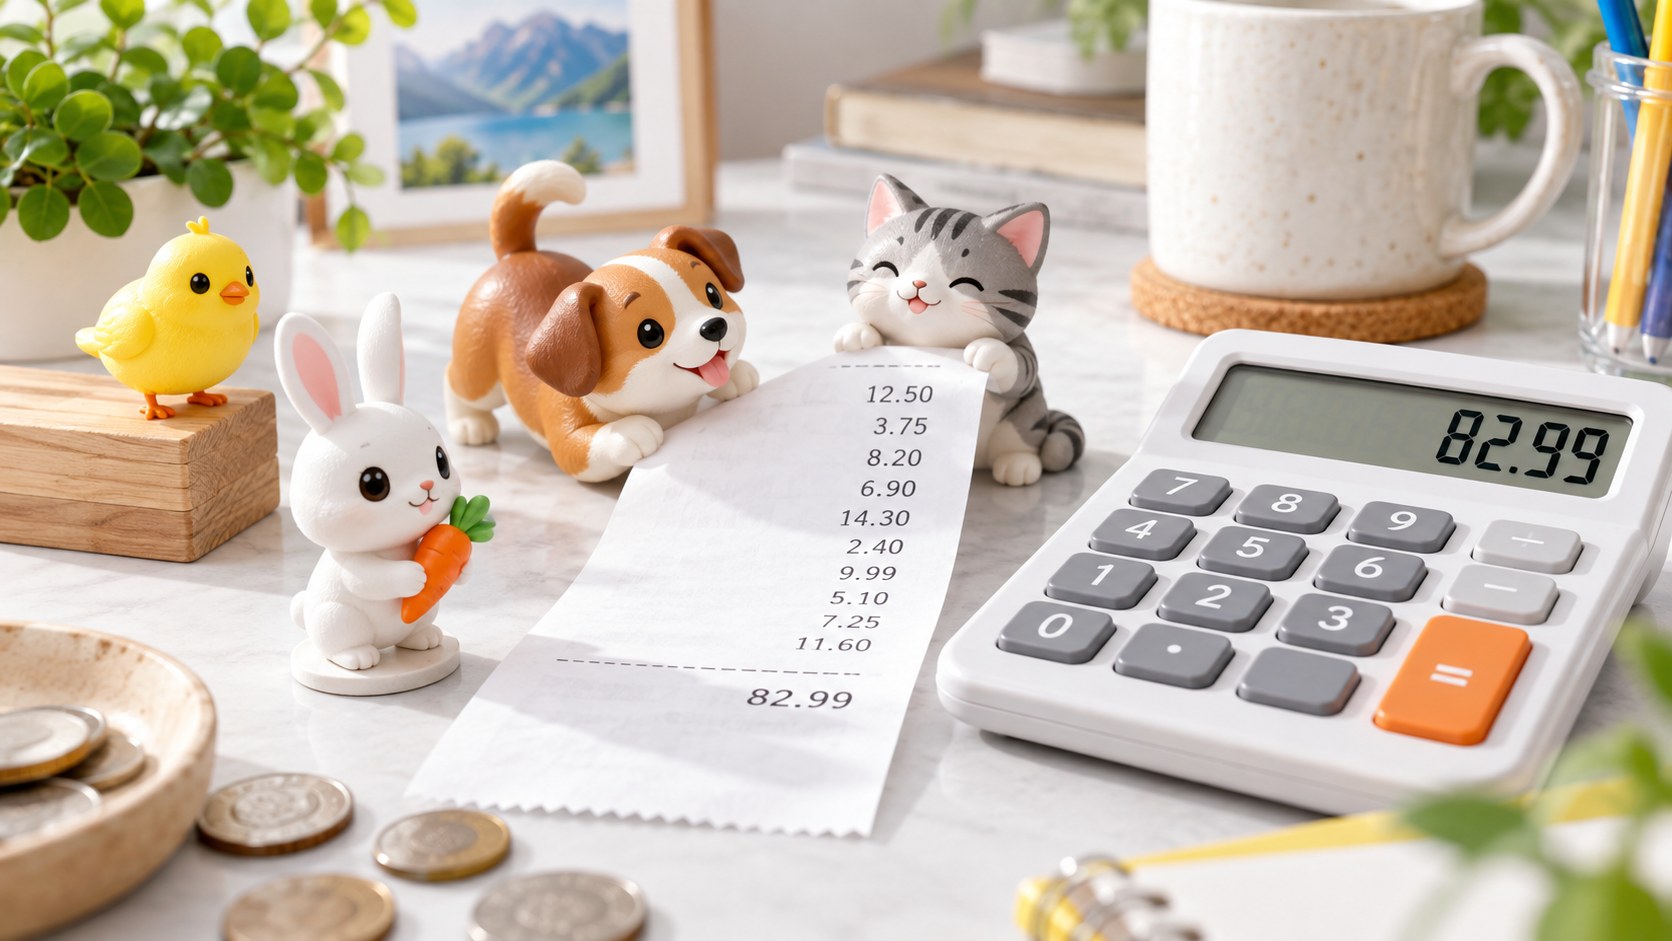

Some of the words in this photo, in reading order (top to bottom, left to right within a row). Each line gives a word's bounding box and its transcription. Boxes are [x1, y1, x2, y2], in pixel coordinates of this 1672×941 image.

[867, 385, 933, 403] 12.50
[873, 417, 928, 435] 3.75
[1435, 408, 1610, 486] 82.99
[867, 448, 922, 467] 8.20
[860, 479, 916, 497] 6.90
[1165, 477, 1200, 496] 7
[1271, 493, 1303, 513] 8
[840, 509, 910, 526] 14.30
[1386, 511, 1418, 531] 9
[1124, 519, 1158, 540] 4
[846, 538, 904, 555] 2.40
[1236, 536, 1271, 558] 5
[839, 566, 897, 581] 9.99
[1089, 564, 1115, 587] 1
[1354, 556, 1386, 580] 6
[830, 591, 889, 606] 5.10
[1194, 585, 1233, 609] 2
[822, 614, 881, 629] 7.25
[1037, 613, 1074, 639] 0
[1317, 605, 1354, 632] 3
[795, 637, 872, 652] 11.60
[747, 688, 853, 709] 82.99
